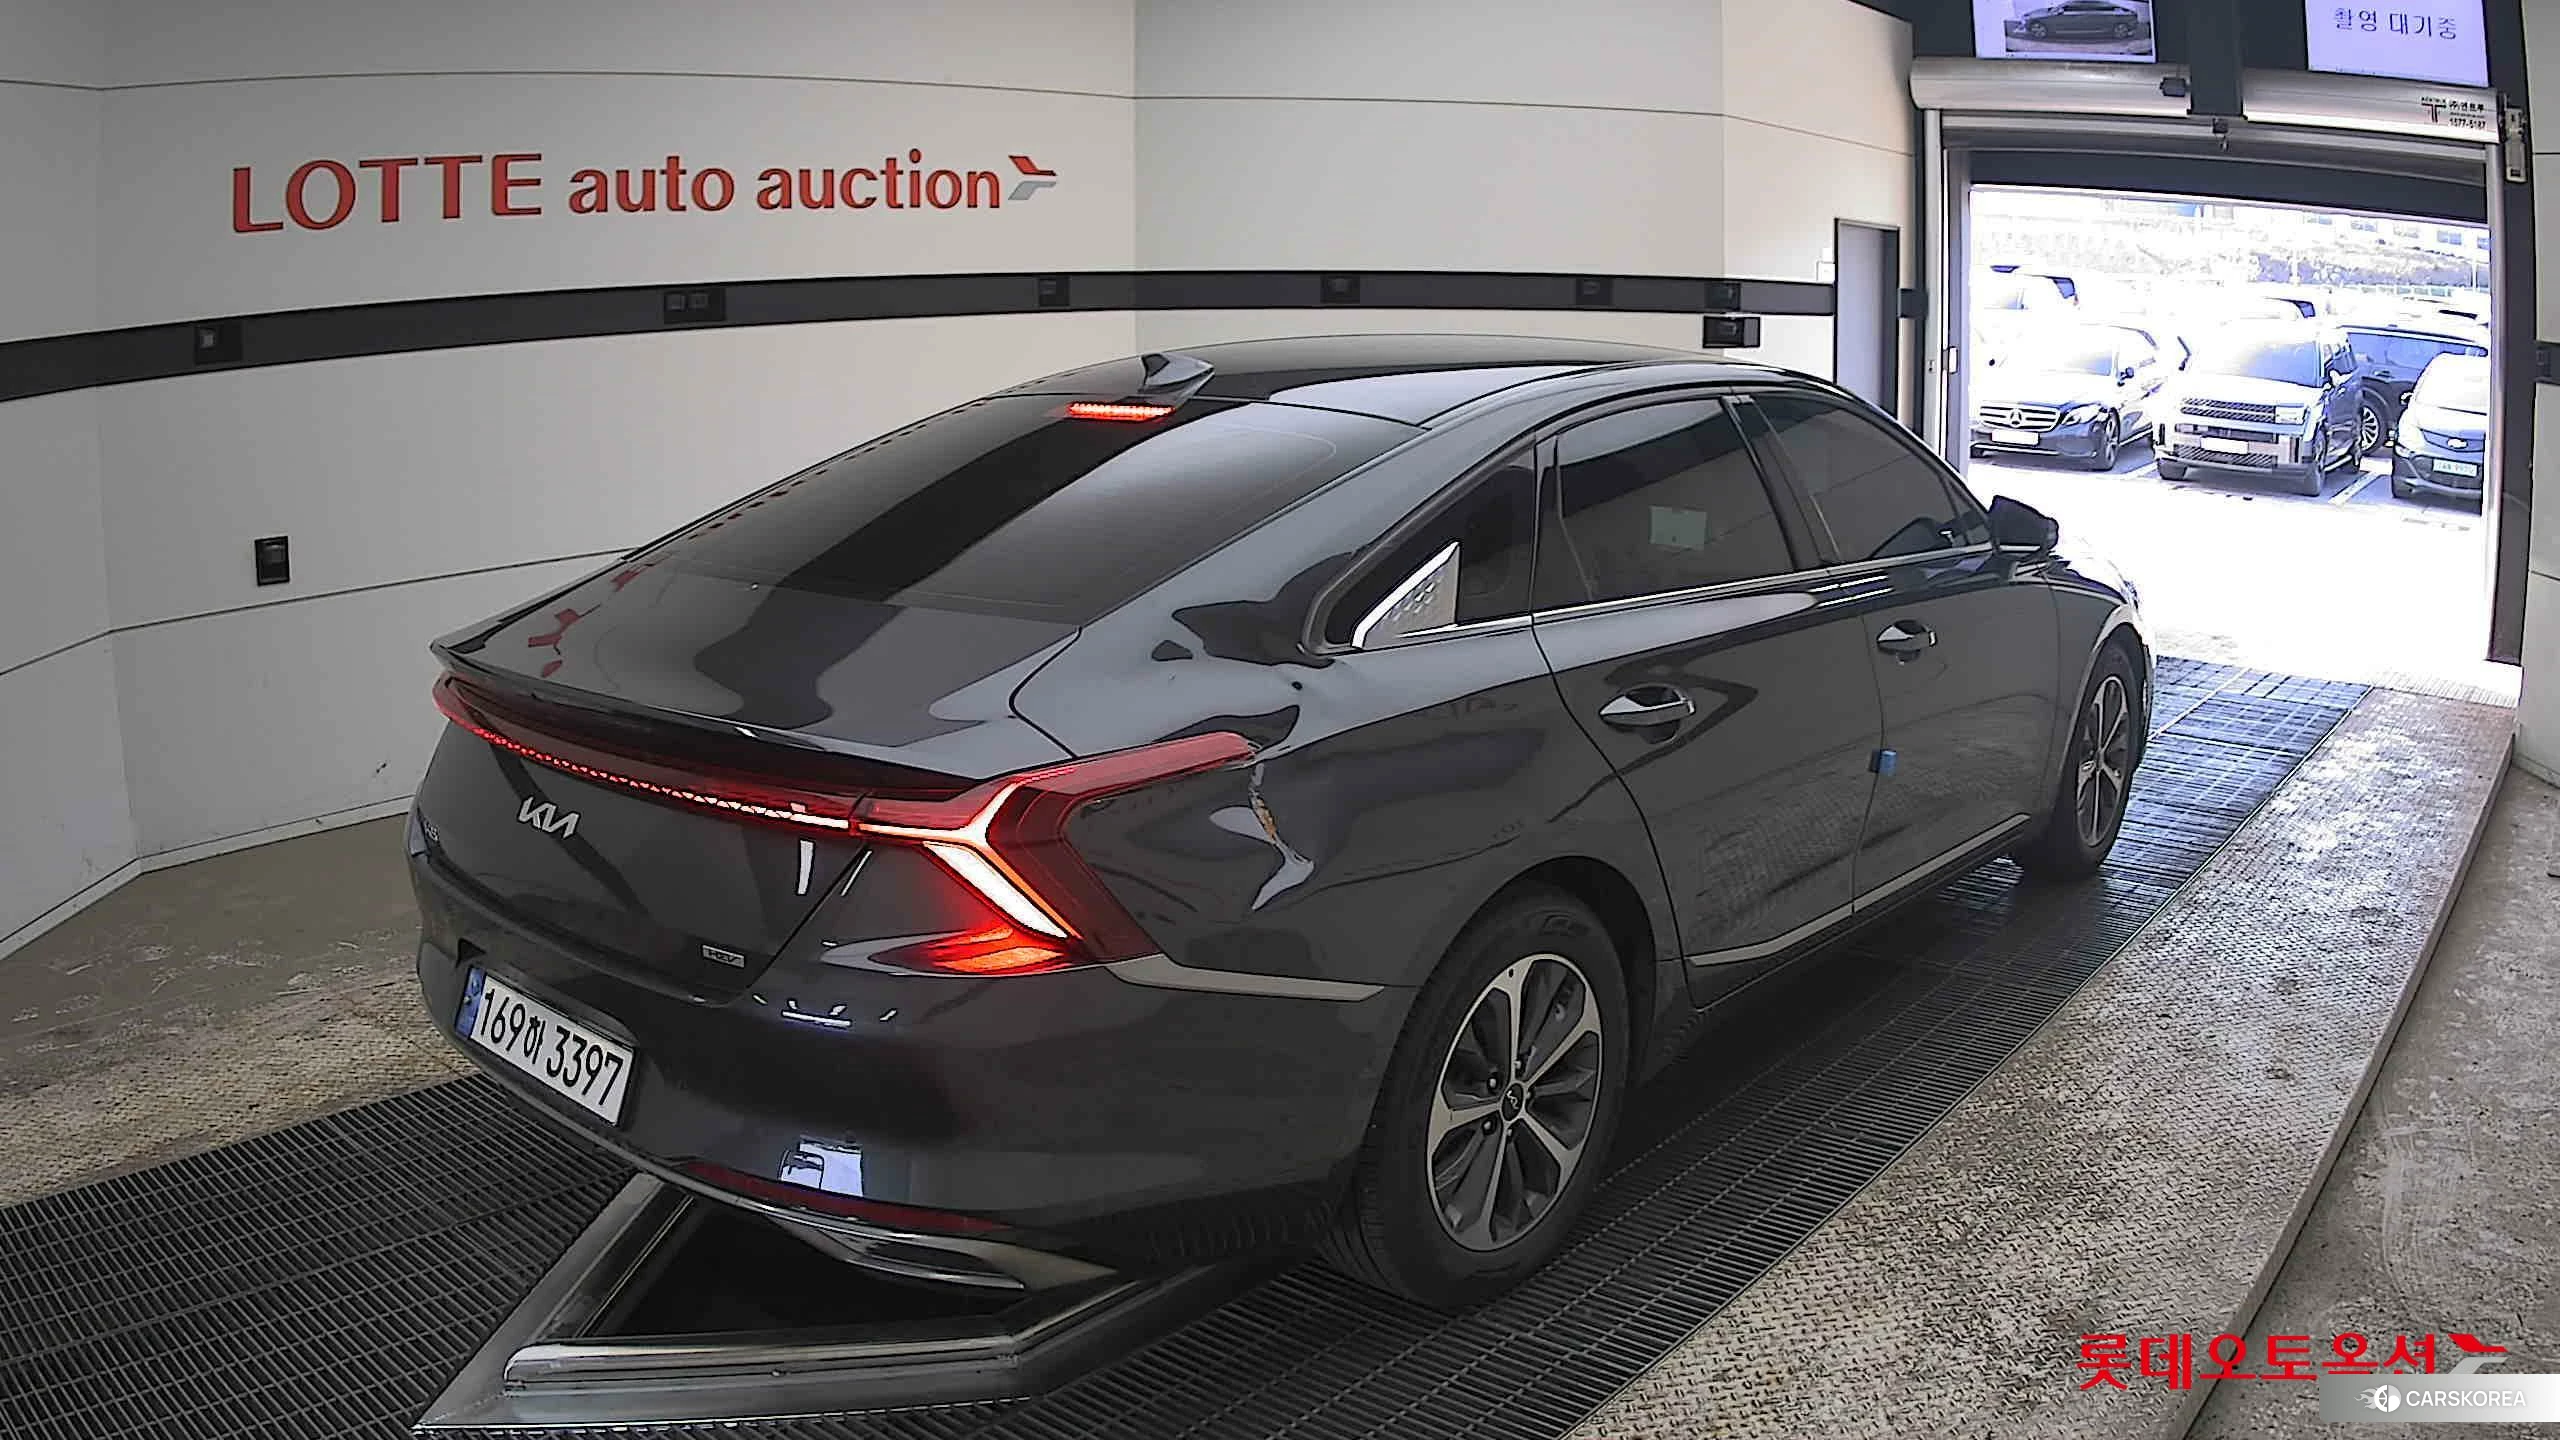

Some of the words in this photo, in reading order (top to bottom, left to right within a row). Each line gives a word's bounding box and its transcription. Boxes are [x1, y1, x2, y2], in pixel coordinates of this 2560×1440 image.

[2389, 13, 2457, 40] 대기중
[233, 153, 543, 233] LOTTE
[568, 154, 735, 213] auto
[756, 148, 1002, 211] auction
[480, 988, 546, 1065] 169하
[546, 1025, 624, 1106] 3397
